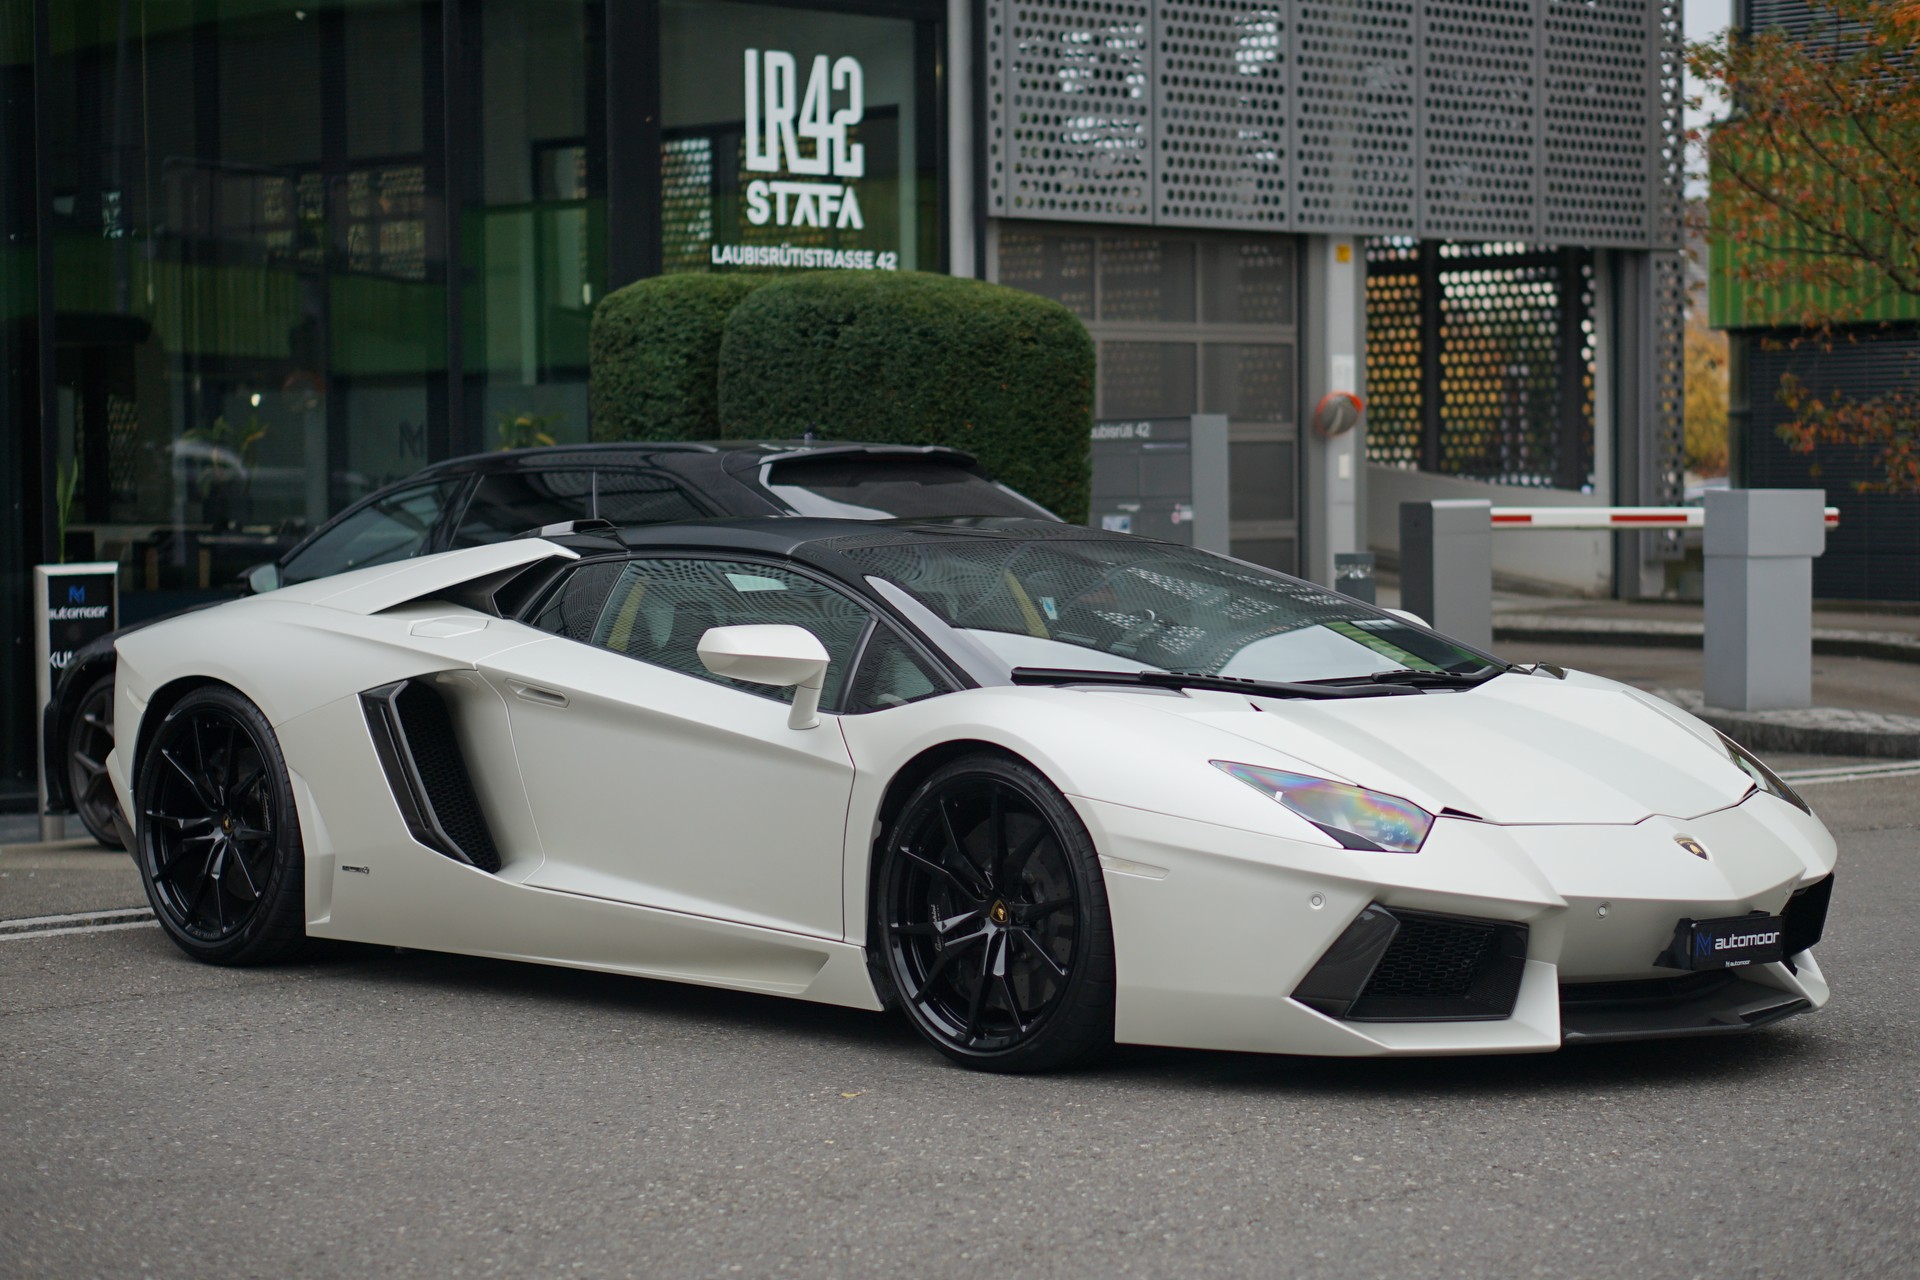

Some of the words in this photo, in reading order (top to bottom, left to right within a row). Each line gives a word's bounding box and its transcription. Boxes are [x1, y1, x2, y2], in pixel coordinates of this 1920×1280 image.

[711, 243, 874, 269] LAUBISRÜTISTRASSE
[875, 251, 898, 271] 42
[1135, 422, 1150, 438] 42
[1715, 932, 1780, 950] automoor
